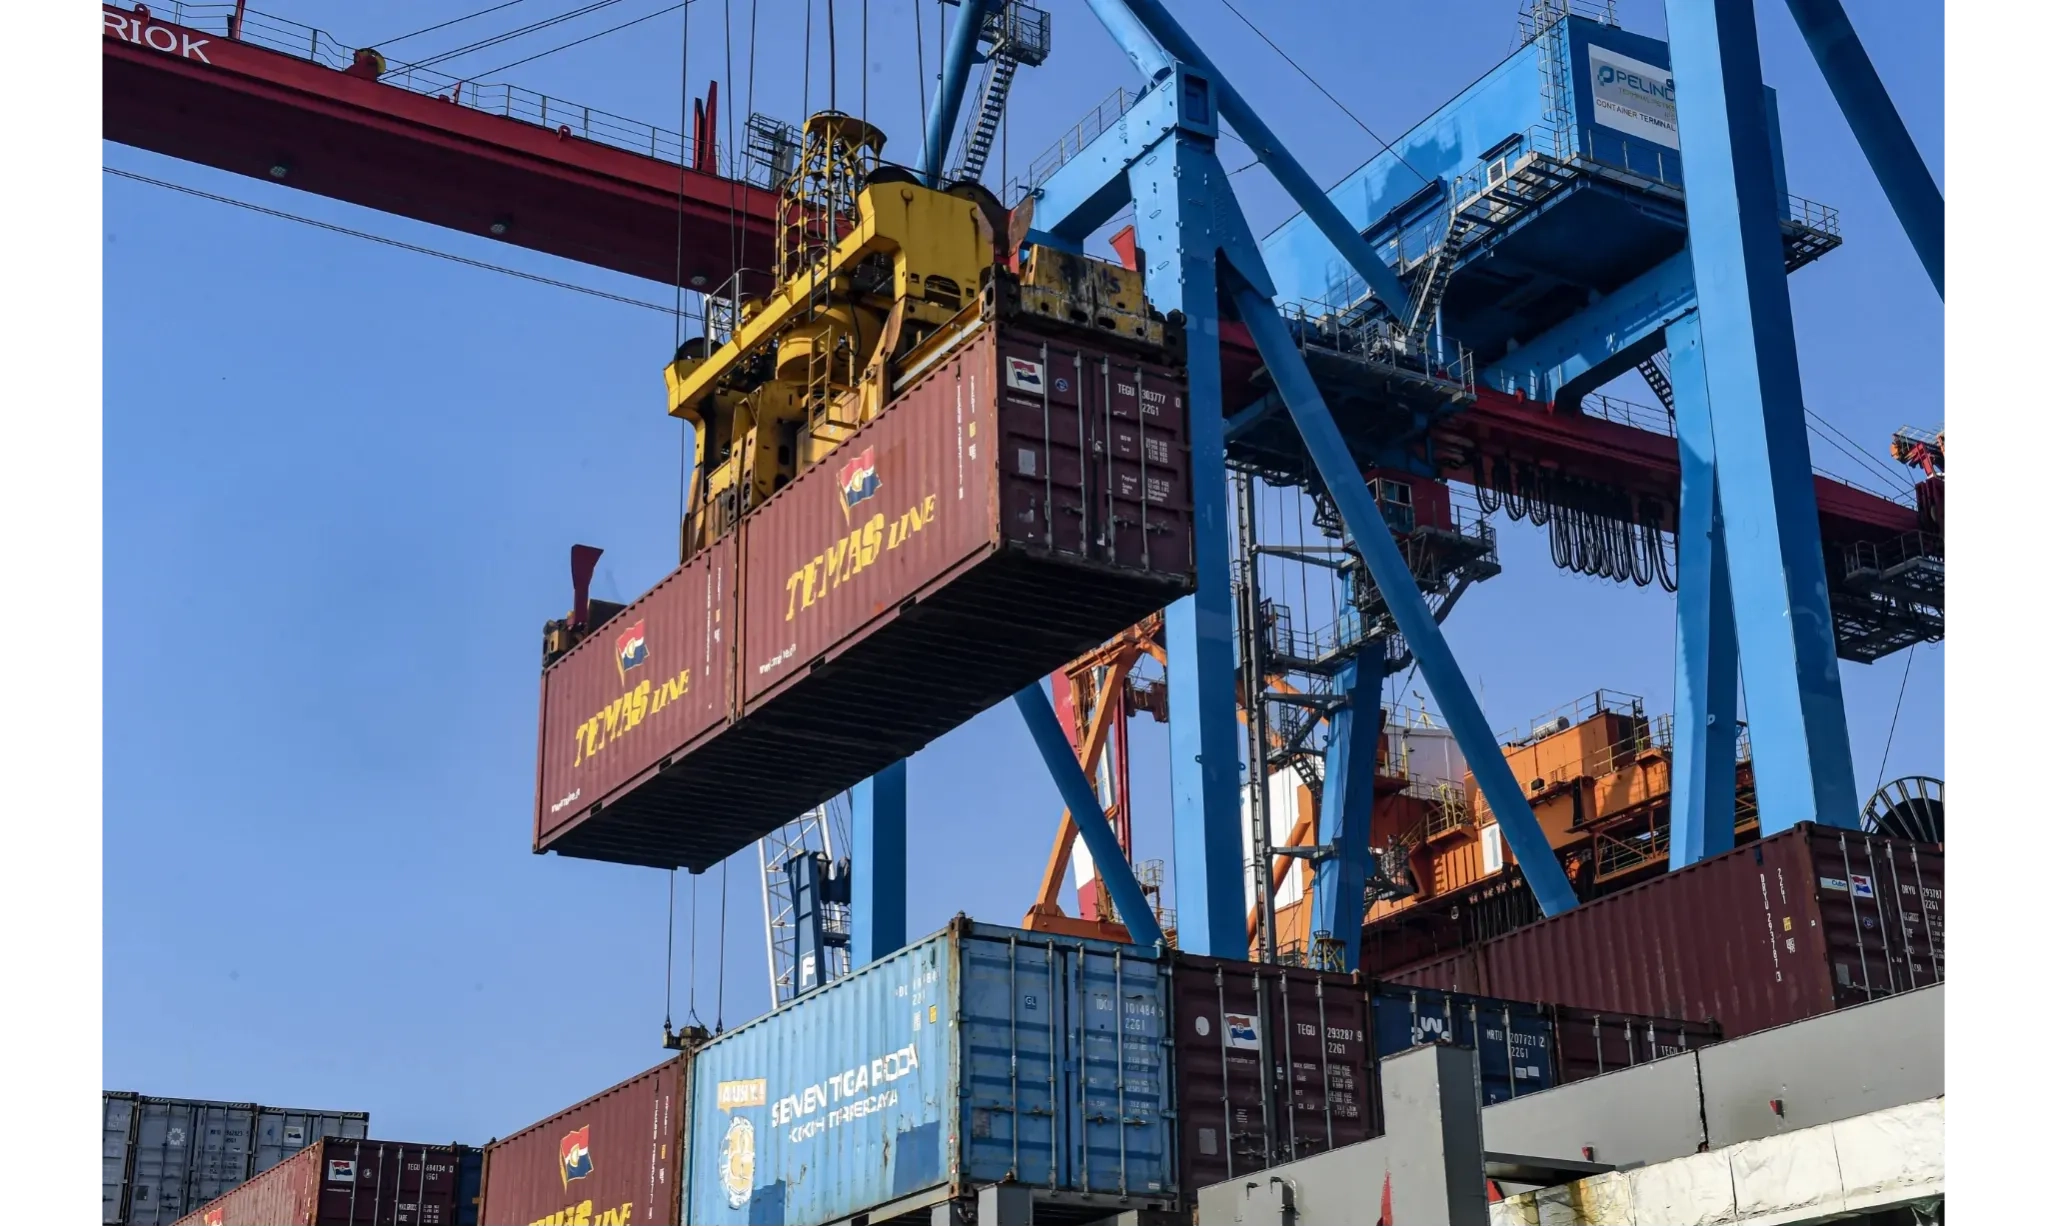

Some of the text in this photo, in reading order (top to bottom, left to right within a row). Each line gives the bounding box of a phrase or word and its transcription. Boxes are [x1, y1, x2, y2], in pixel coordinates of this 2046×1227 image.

[101, 10, 211, 65] RIOK
[1596, 98, 1638, 119] CONTAINER
[1640, 113, 1676, 131] TERMINAL
[1117, 383, 1135, 397] TEGU
[785, 513, 885, 622] TEMAS
[886, 494, 937, 551] LINE
[574, 668, 691, 768] TEMAS LINE
[1297, 1023, 1316, 1036] TEGU
[1326, 1026, 1354, 1041] 293287
